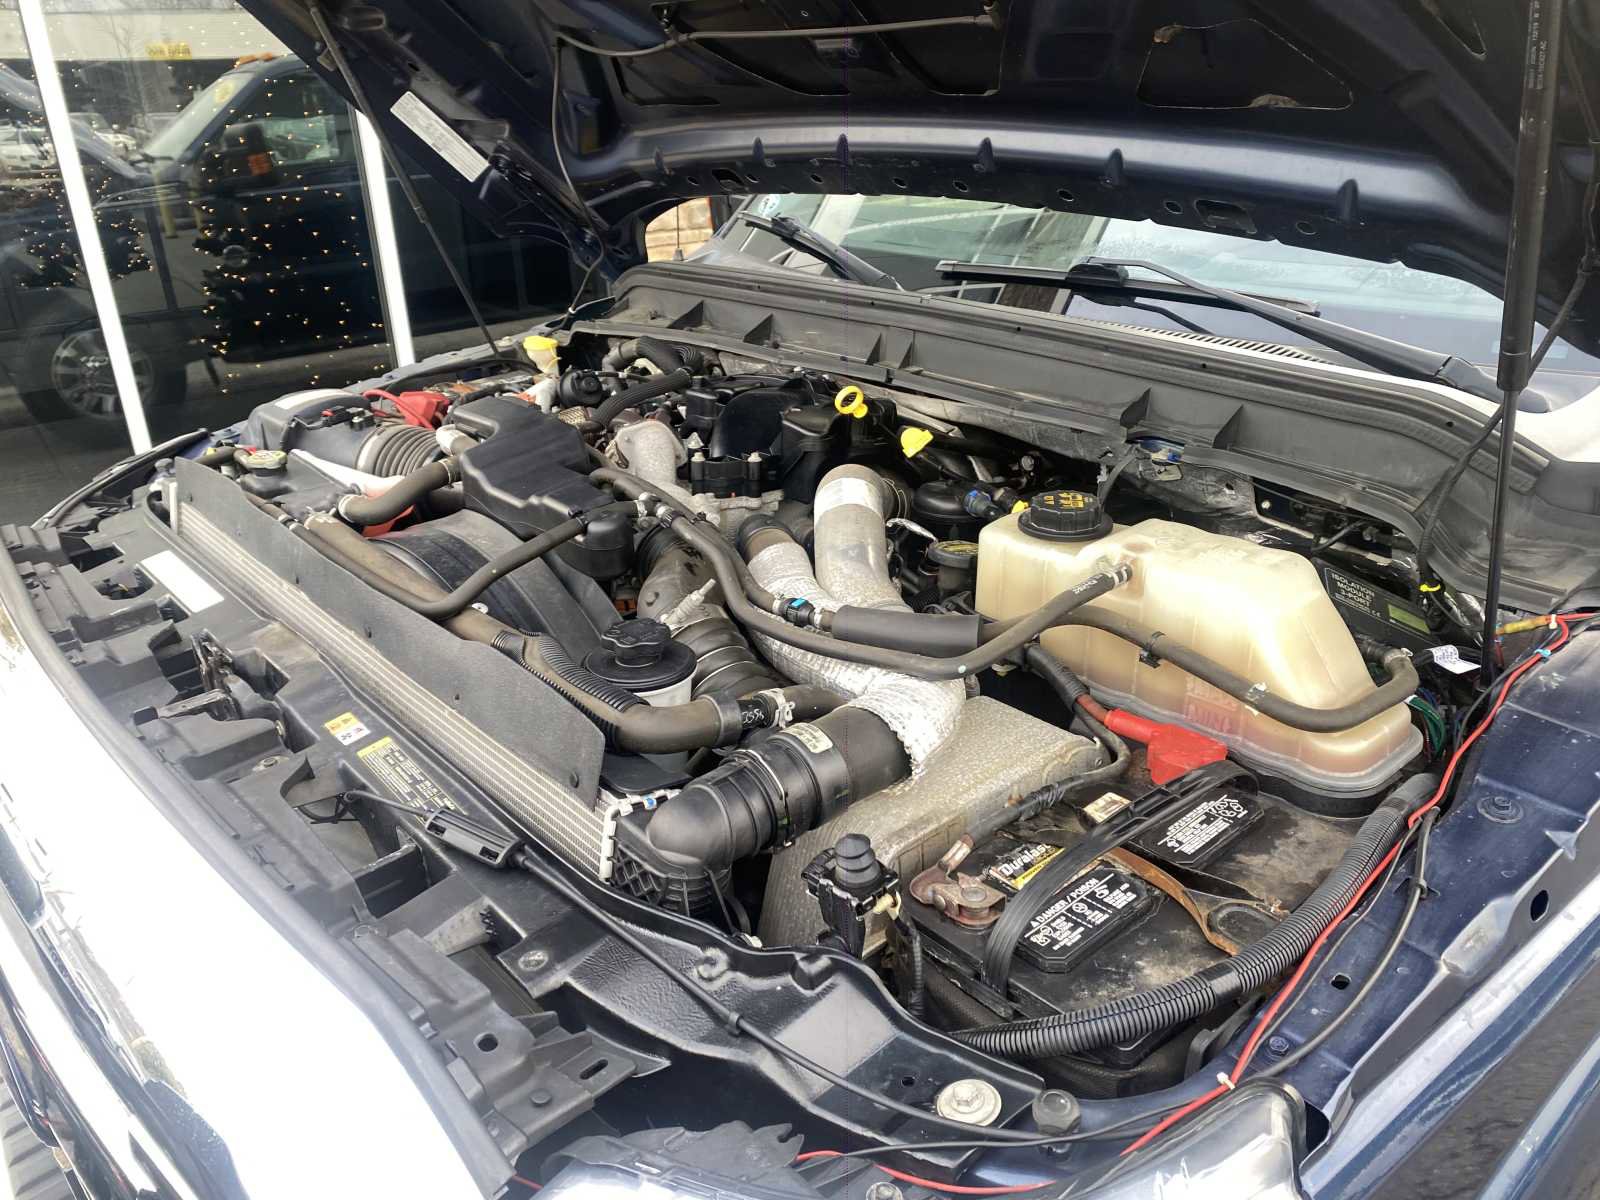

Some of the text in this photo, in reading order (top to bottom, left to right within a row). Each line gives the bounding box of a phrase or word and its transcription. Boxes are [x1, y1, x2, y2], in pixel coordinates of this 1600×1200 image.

[1331, 573, 1375, 597] ISOLATION
[1336, 581, 1372, 601] MODULE
[998, 843, 1051, 876] Duralast
[1037, 899, 1069, 923] DANGER
[1071, 878, 1100, 899] POISON
